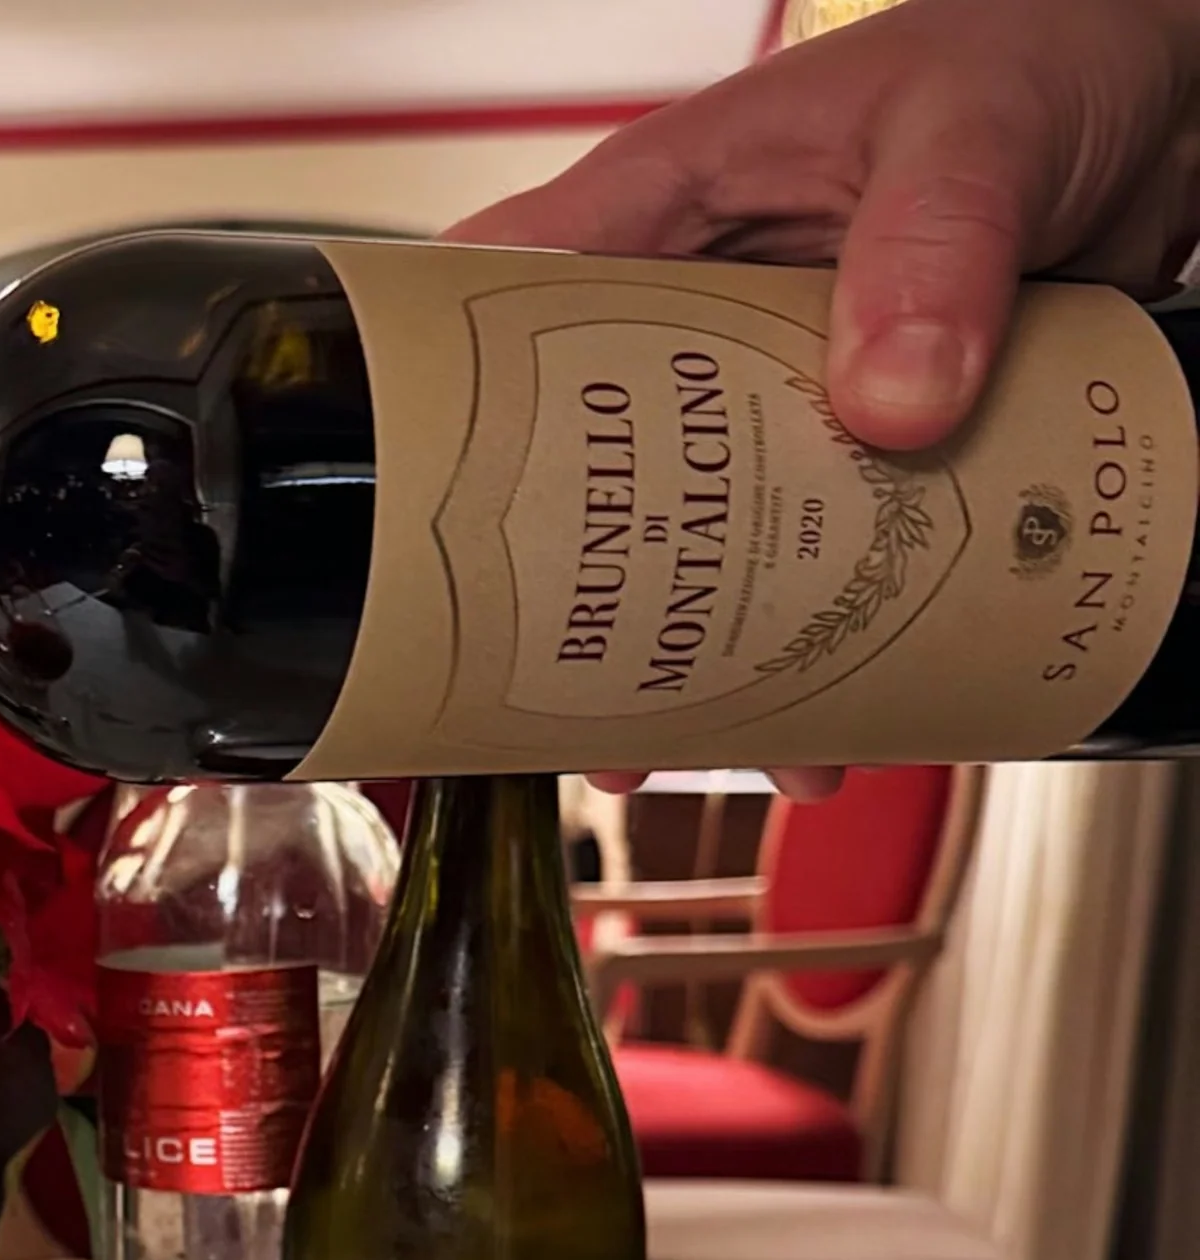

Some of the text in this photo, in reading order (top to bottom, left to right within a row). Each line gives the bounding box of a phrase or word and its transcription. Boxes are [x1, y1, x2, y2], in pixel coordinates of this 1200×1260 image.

[556, 382, 636, 663] BRUNELLO
[636, 351, 731, 692] MONTALCINO
[643, 515, 670, 544] DI
[797, 497, 825, 560] 2020
[1043, 380, 1128, 682] SAN POLO
[1113, 434, 1157, 633] MONTALCINO
